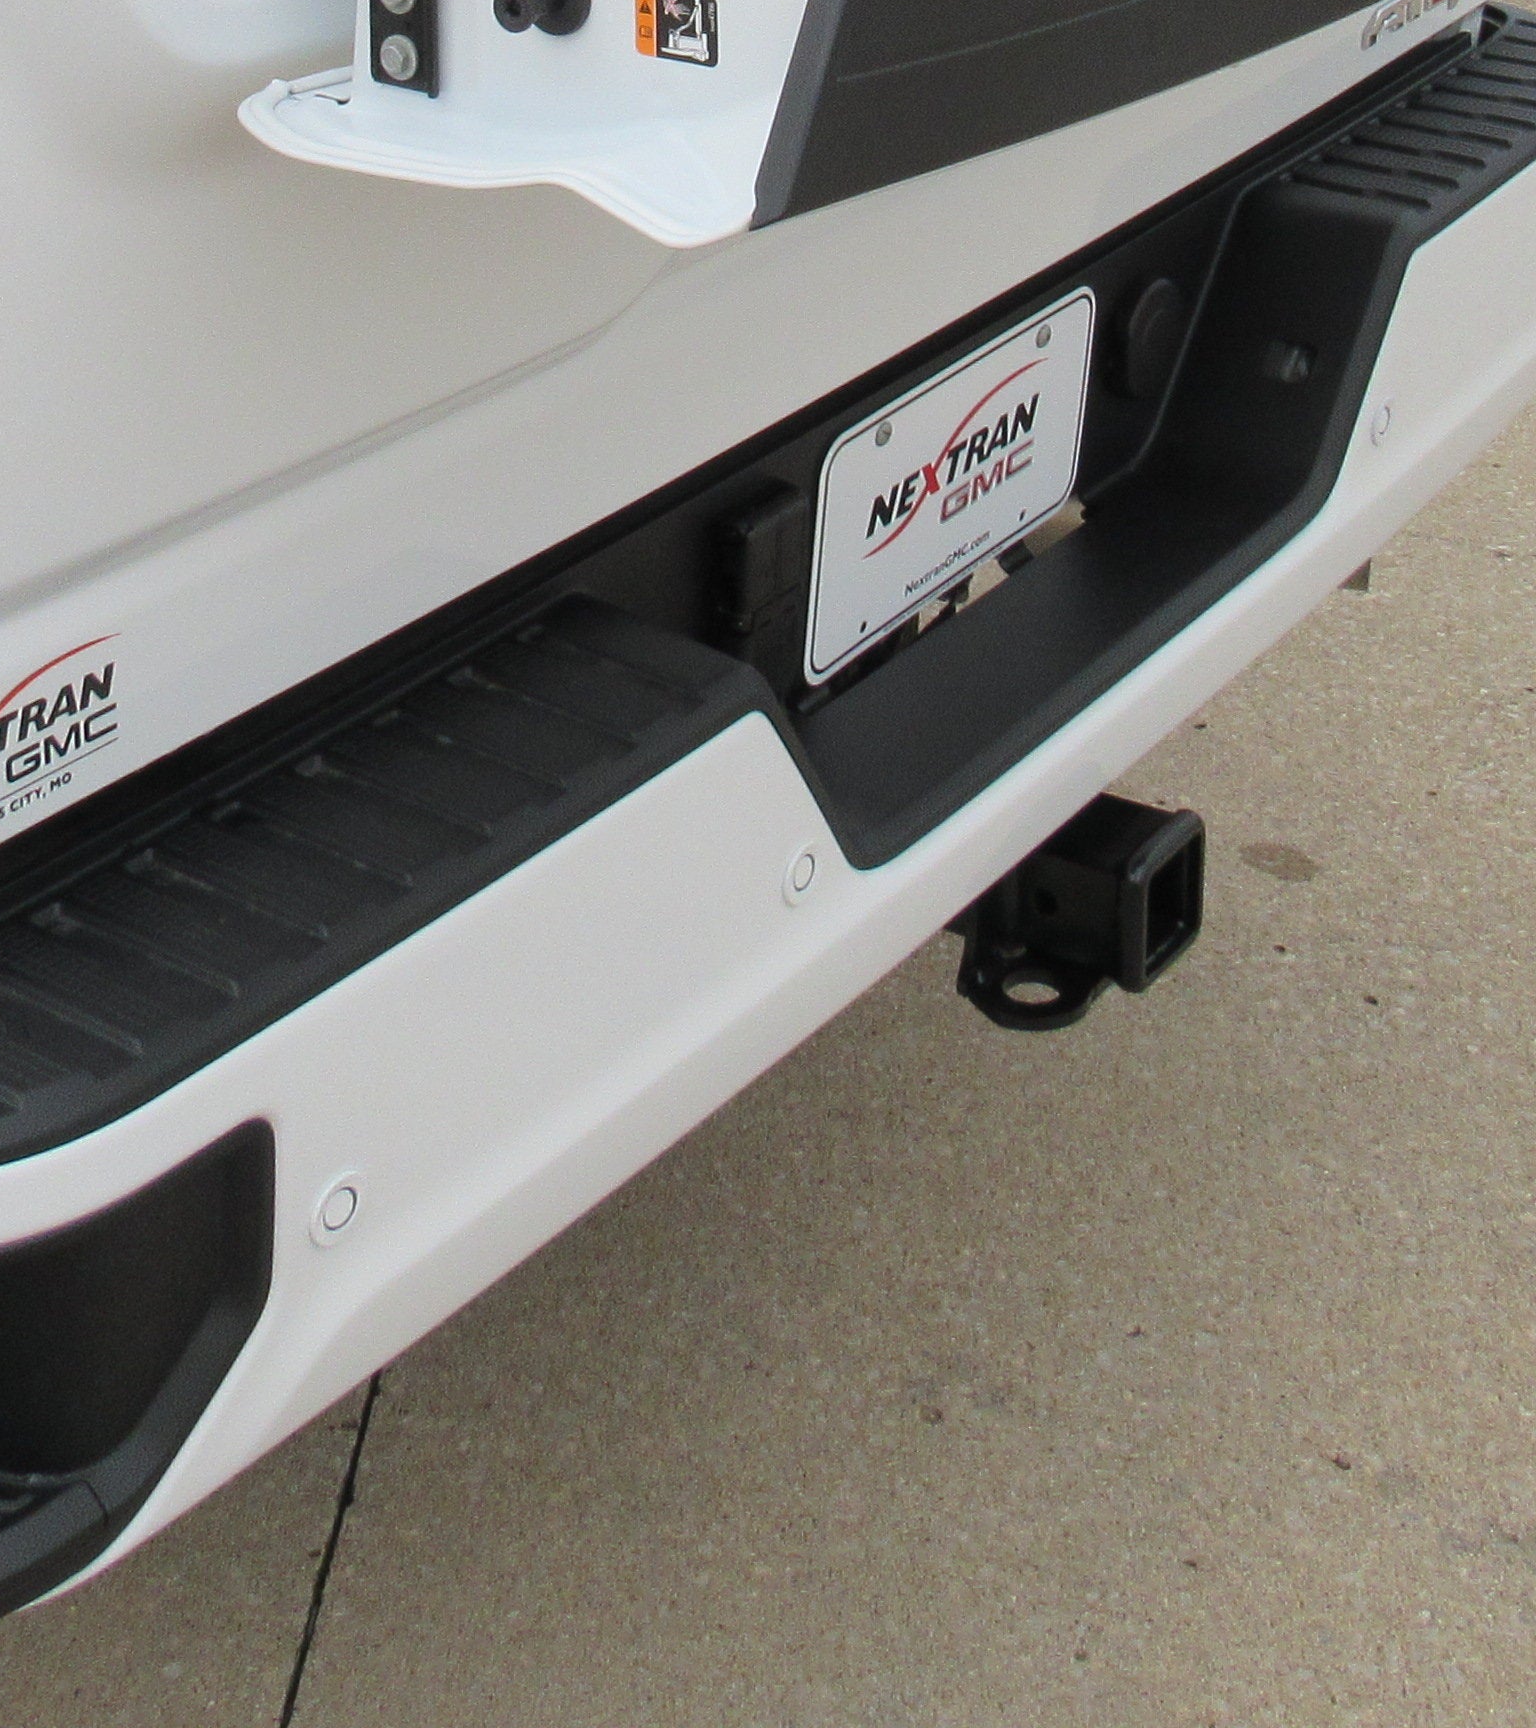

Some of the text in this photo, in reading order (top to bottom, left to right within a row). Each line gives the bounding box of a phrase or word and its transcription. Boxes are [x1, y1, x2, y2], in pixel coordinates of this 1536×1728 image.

[866, 393, 1040, 539] NEXTRAN
[939, 439, 1035, 523] GMC
[5, 702, 117, 783] GMC
[9, 786, 48, 814] CITY,
[49, 771, 73, 793] MO
